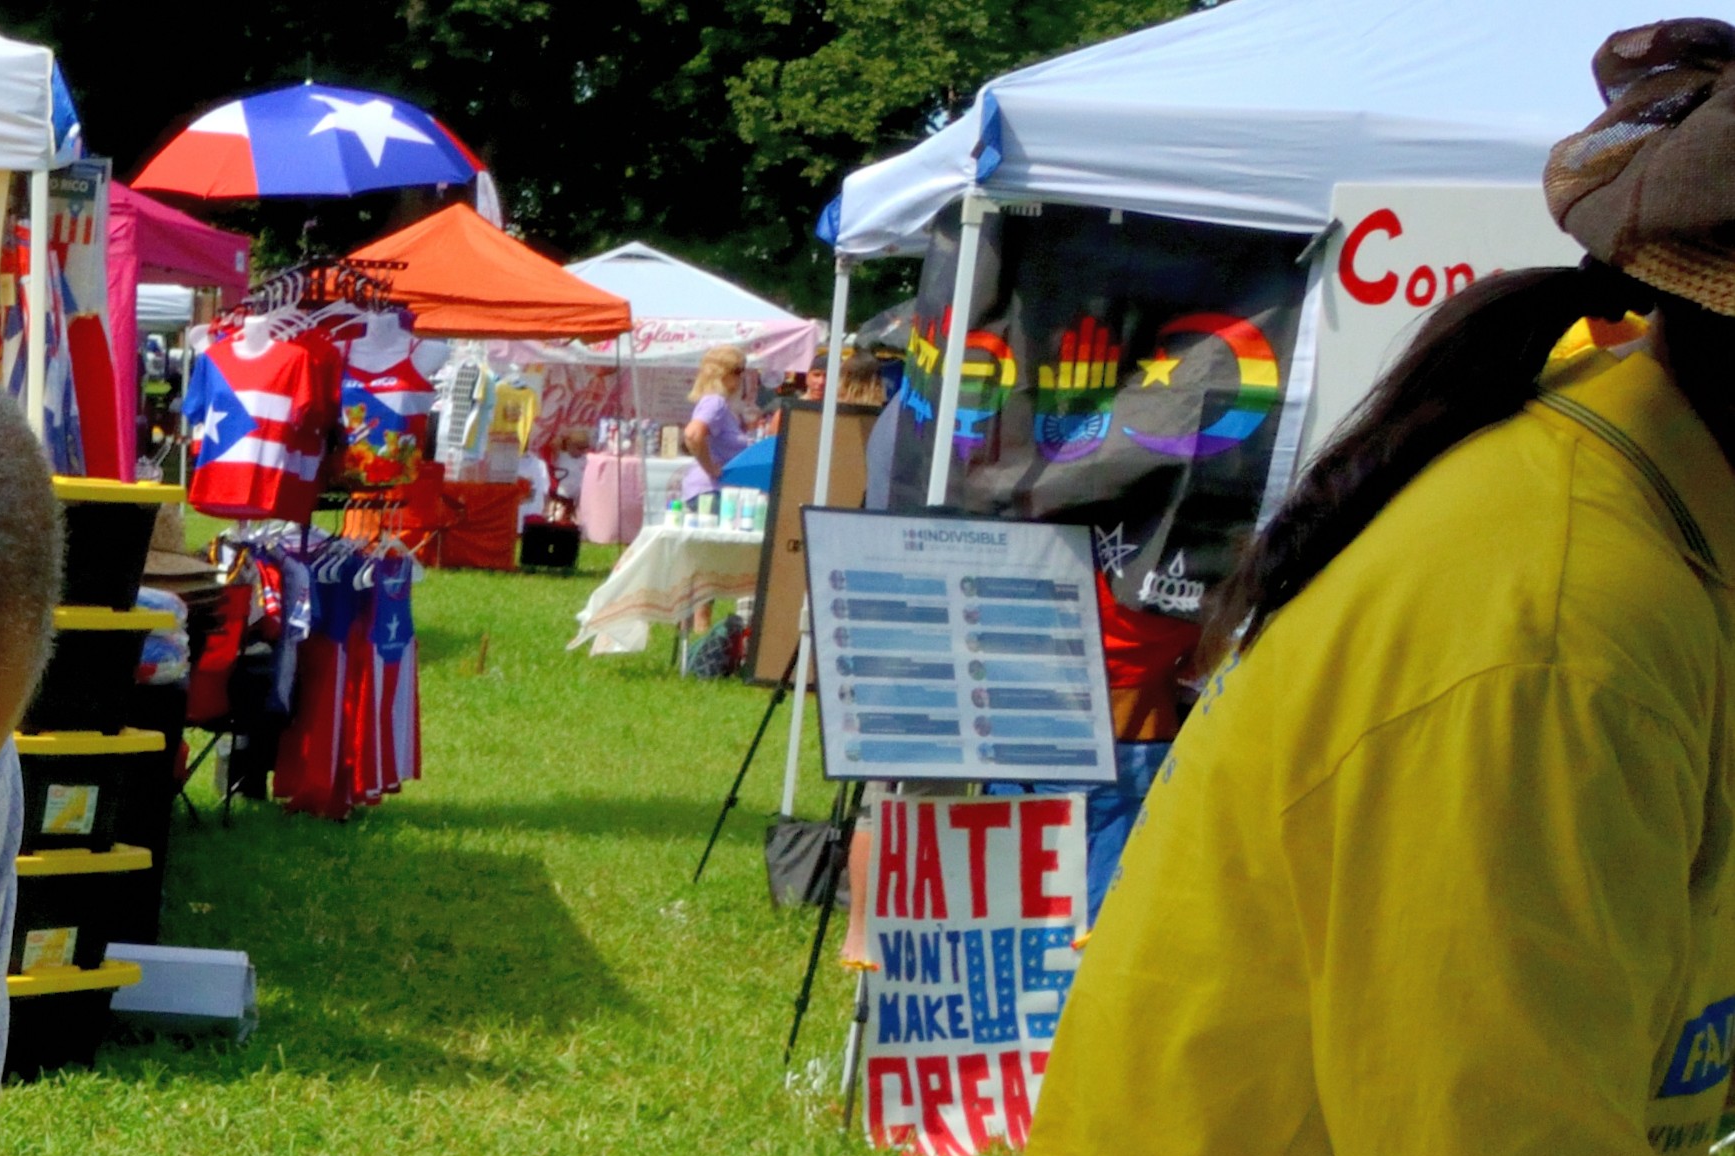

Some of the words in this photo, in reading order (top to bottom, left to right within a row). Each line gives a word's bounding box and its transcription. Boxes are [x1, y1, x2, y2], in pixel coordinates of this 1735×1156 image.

[1338, 208, 1506, 307] Con
[632, 321, 688, 350] Glam
[922, 529, 1007, 546] INDIVISIBLE
[875, 798, 1072, 920] HATE
[877, 992, 969, 1044] MAKE
[964, 925, 1075, 1044] US
